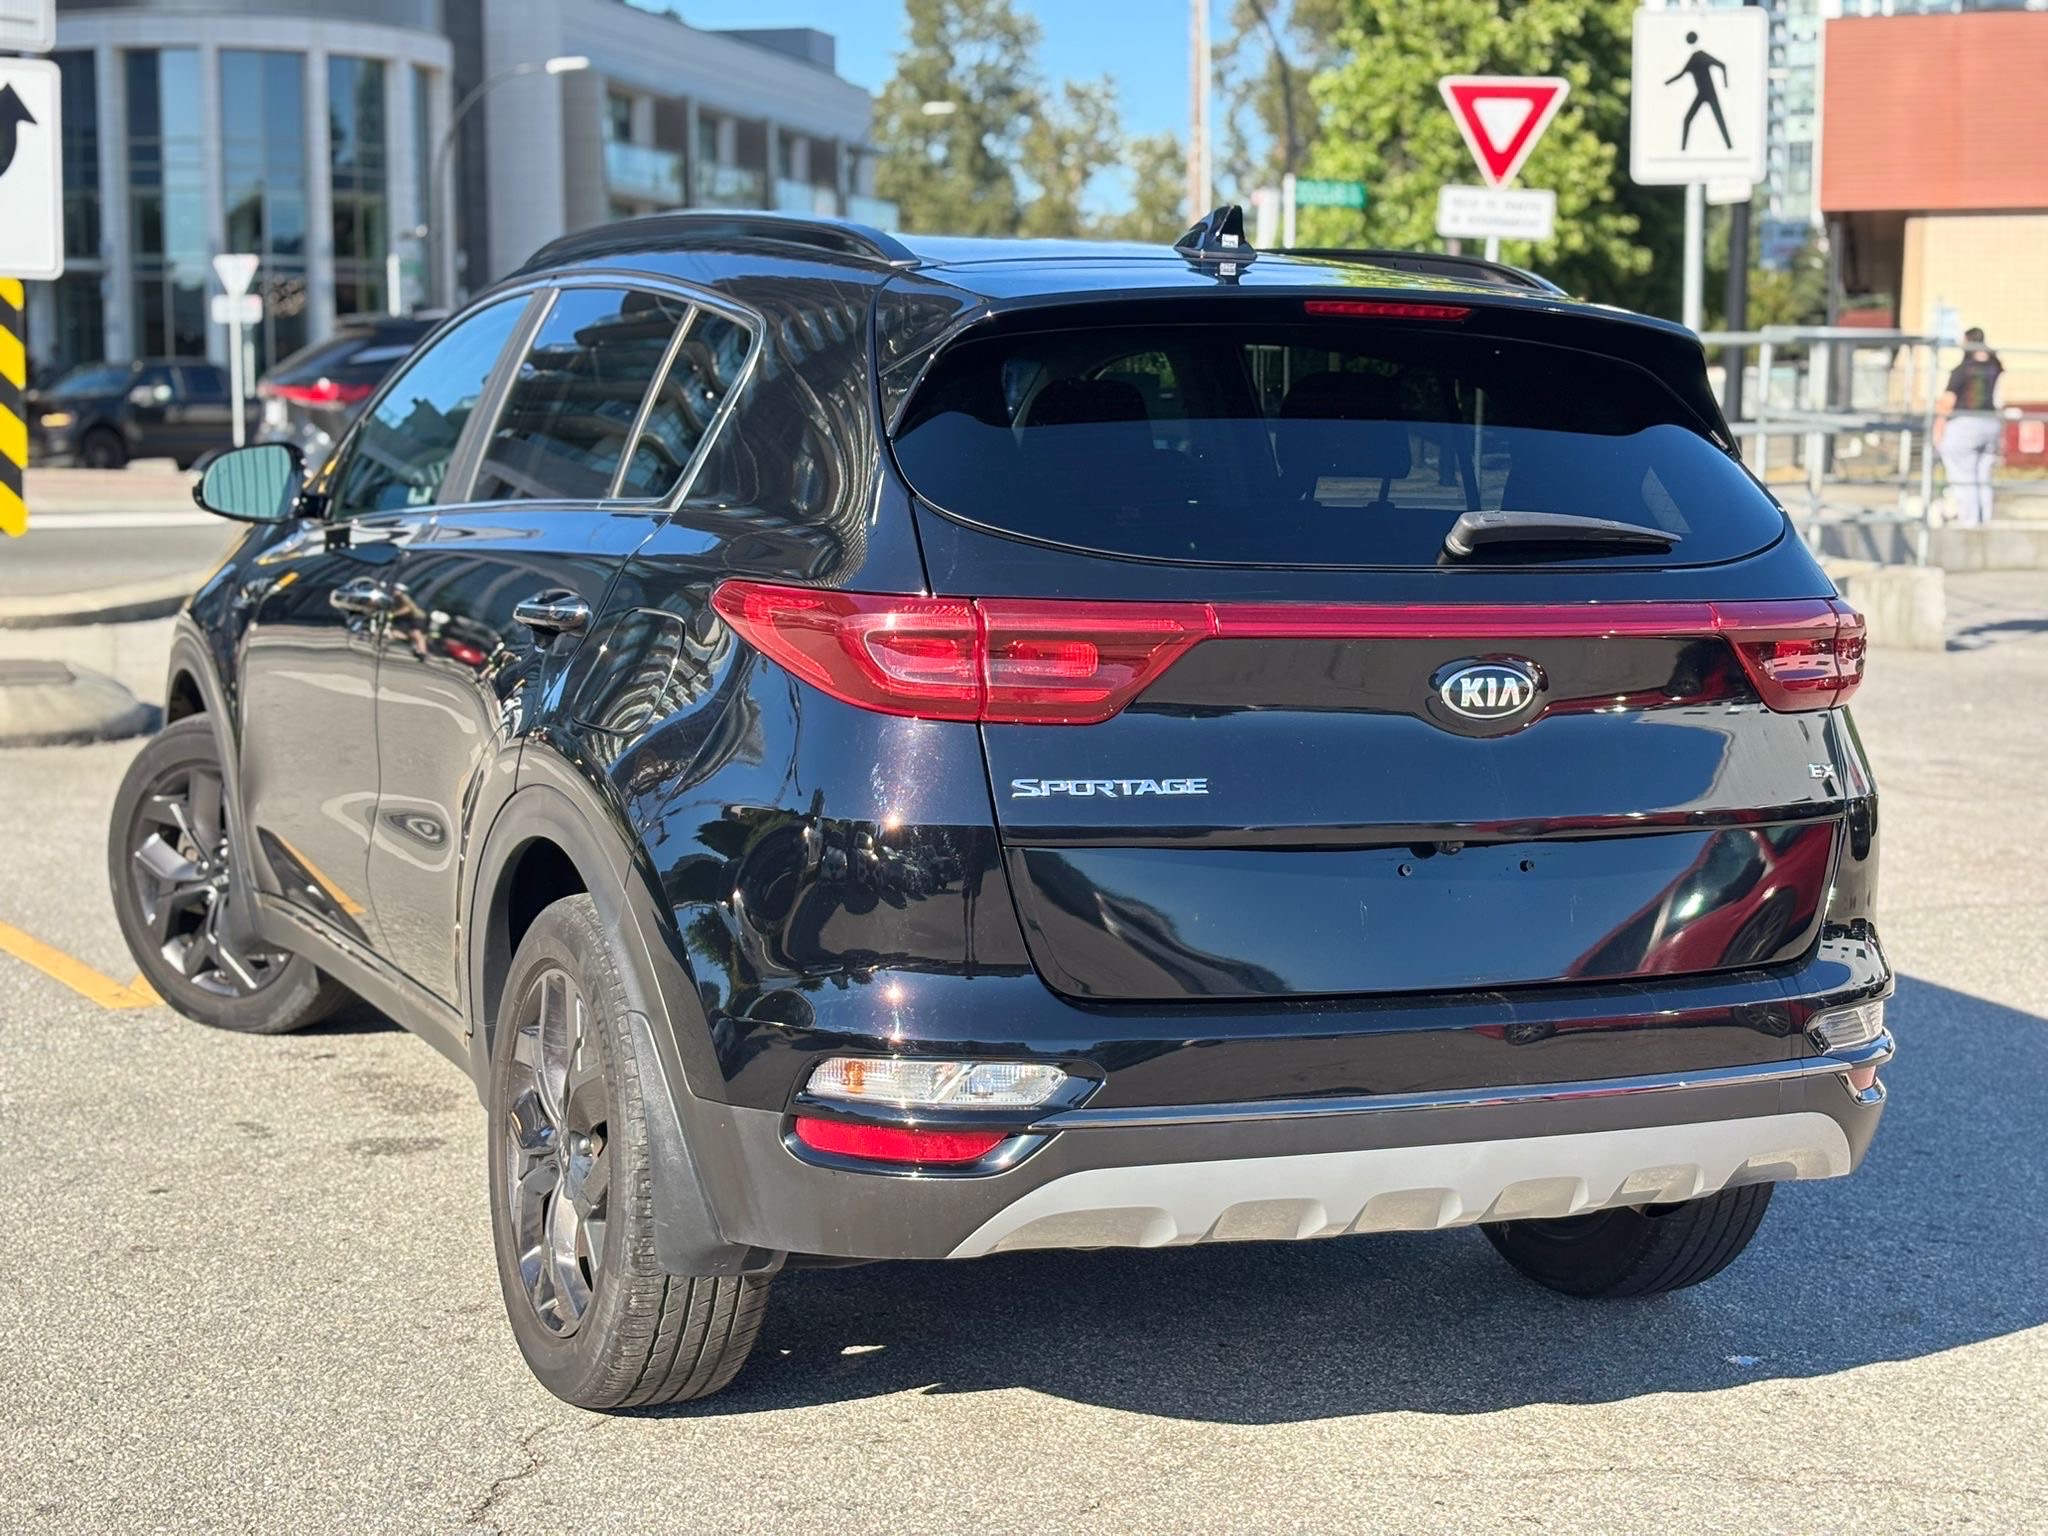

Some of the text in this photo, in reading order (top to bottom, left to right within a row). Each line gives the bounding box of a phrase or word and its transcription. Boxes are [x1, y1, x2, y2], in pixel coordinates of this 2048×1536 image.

[1459, 677, 1521, 707] KIA
[1808, 763, 1834, 778] EX
[1011, 778, 1209, 798] SPORTAGE
